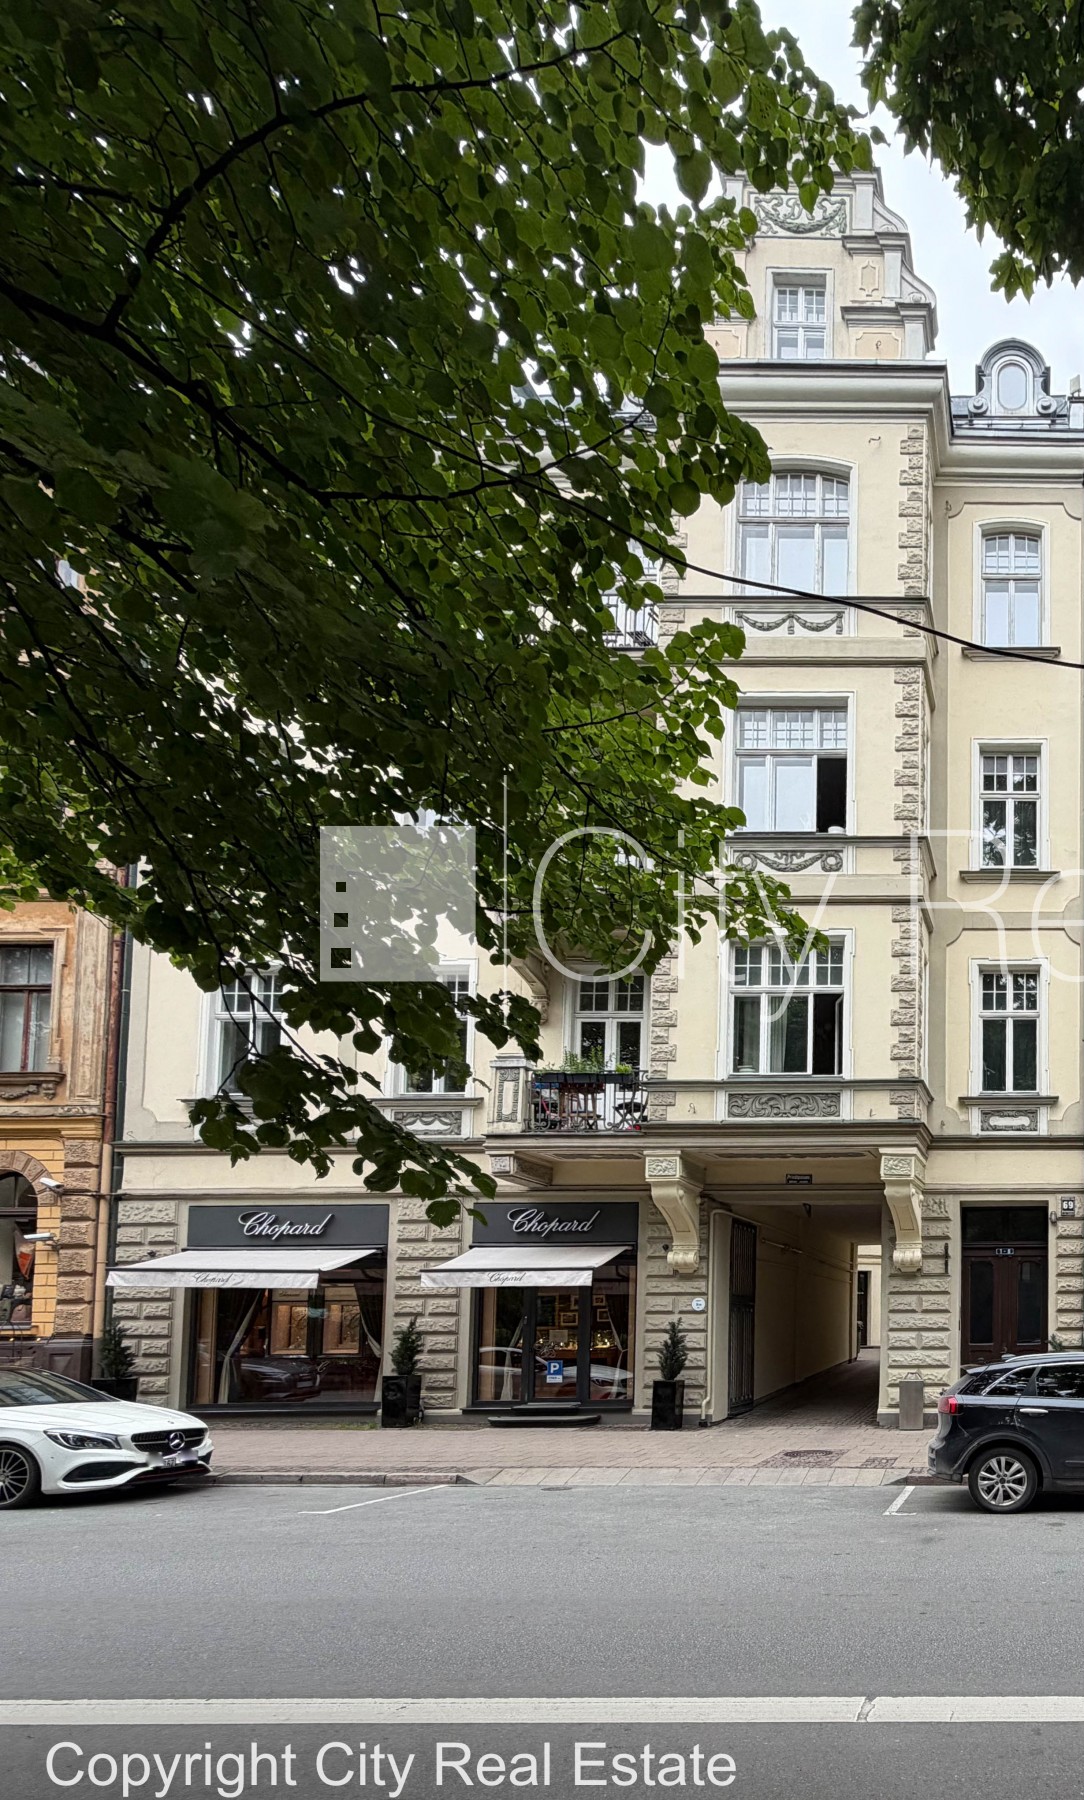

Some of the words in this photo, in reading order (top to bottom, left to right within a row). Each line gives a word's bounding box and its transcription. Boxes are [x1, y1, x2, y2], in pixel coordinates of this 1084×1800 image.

[1063, 1201, 1073, 1210] 69
[238, 1211, 332, 1240] Chopard
[507, 1207, 600, 1237] Chopard
[487, 1272, 526, 1285] Chopard
[550, 1363, 560, 1374] P
